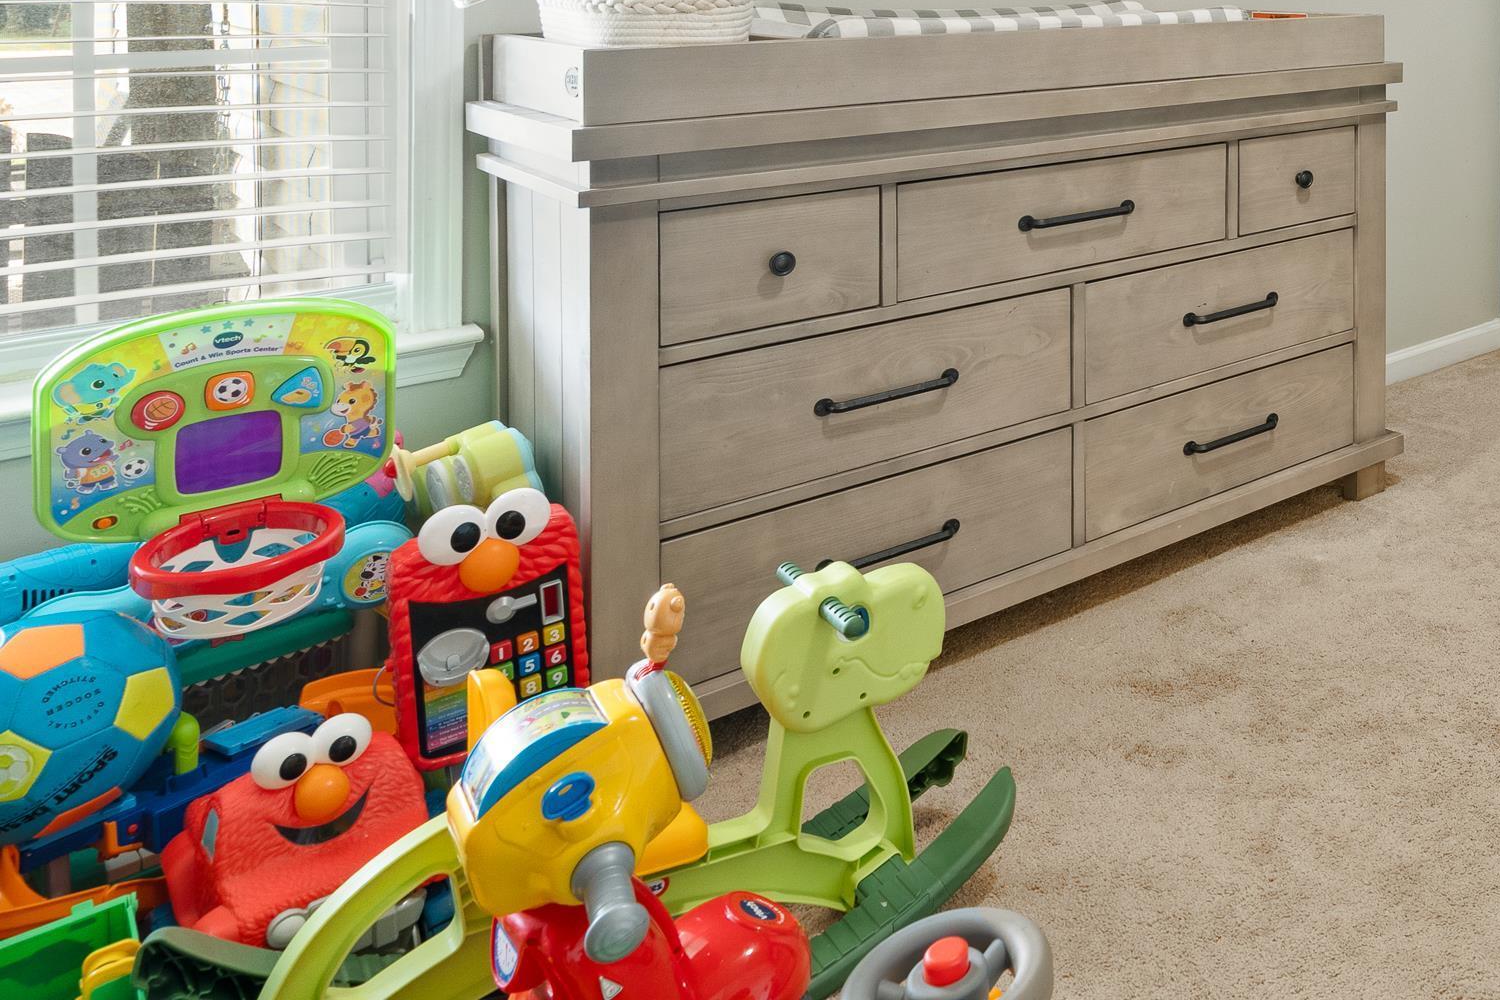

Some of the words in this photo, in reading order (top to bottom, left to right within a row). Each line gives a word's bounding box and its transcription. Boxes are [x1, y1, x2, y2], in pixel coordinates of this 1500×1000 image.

[175, 357, 198, 368] Count
[226, 348, 251, 356] Sports
[498, 647, 504, 659] 1
[523, 638, 534, 652] 2
[550, 629, 560, 642] 3
[525, 659, 535, 673] 5
[551, 650, 561, 664] 6
[42, 675, 97, 704] STITCHED
[526, 681, 537, 694] 8
[552, 671, 563, 685] 9
[46, 689, 101, 717] SOCCER
[47, 701, 105, 729] OFFICIAL
[53, 748, 119, 805] SPORT
